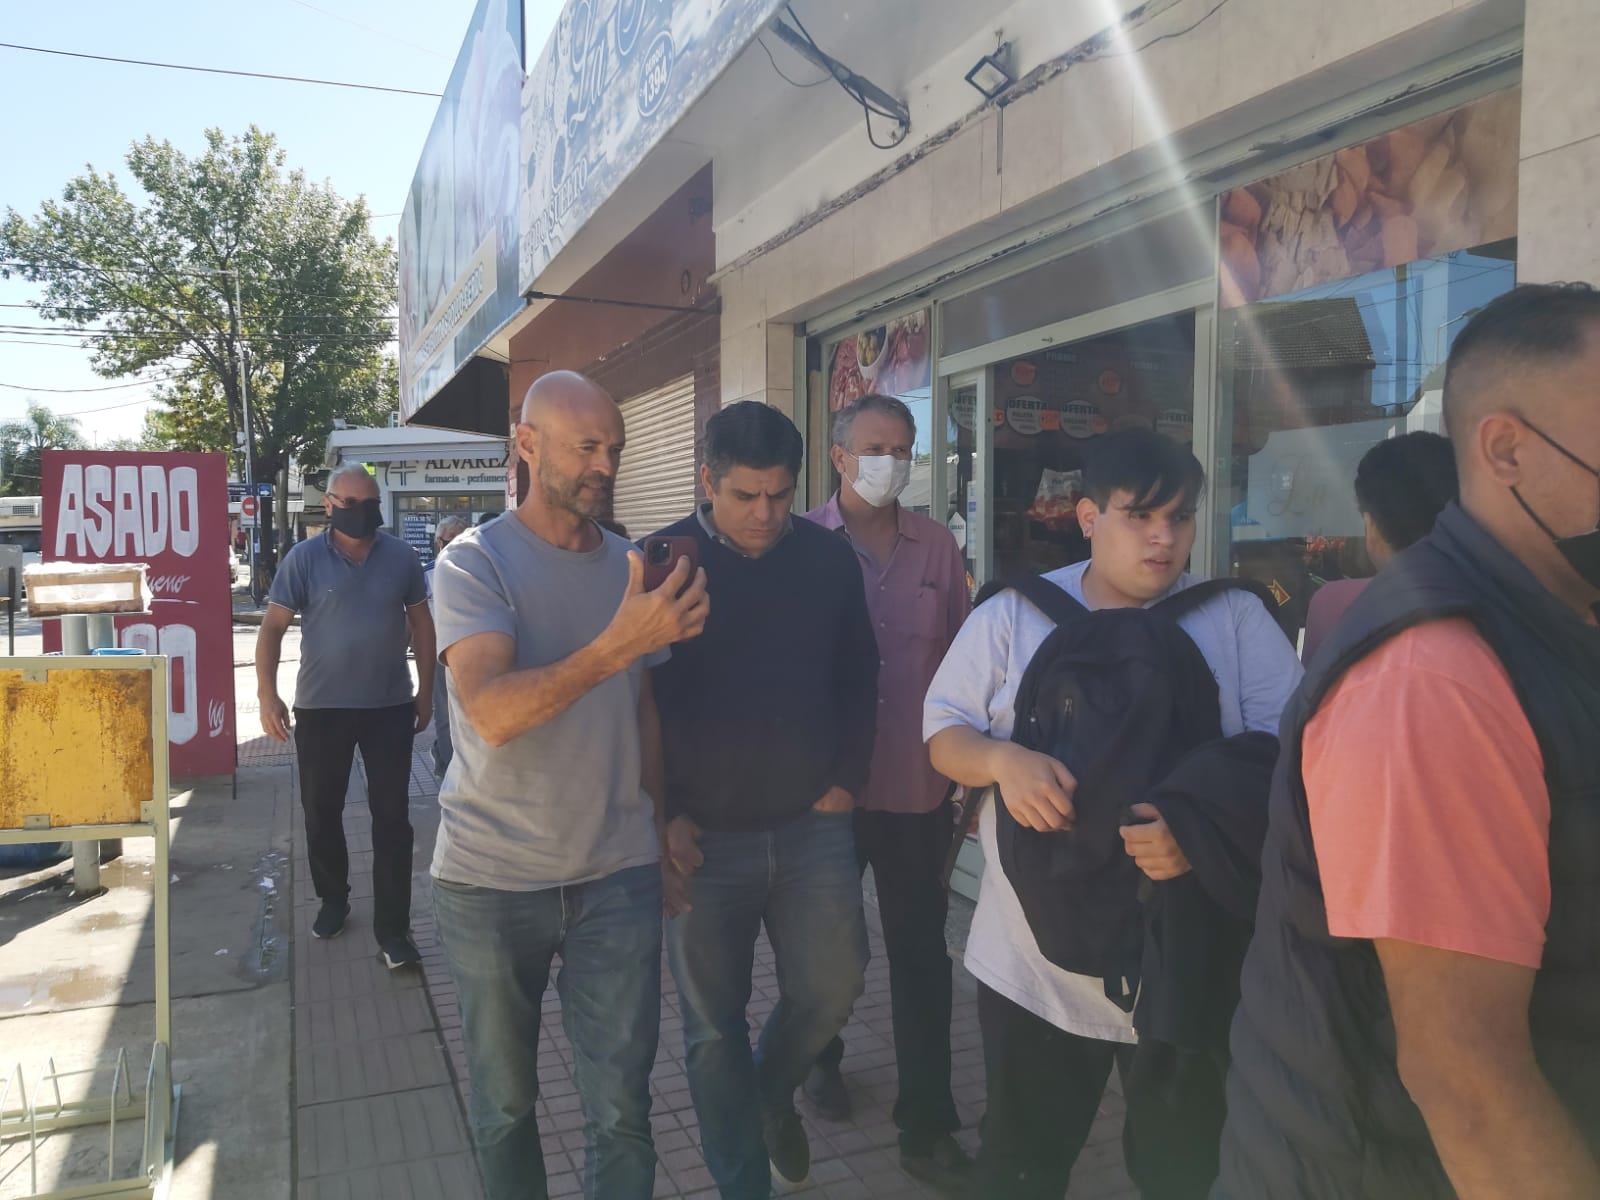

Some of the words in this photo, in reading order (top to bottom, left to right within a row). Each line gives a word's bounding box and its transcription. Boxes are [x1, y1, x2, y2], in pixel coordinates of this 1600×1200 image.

[643, 55, 667, 107] 1394
[424, 473, 460, 483] farmacia
[55, 464, 199, 558] ASADO
[150, 574, 191, 593] ueno
